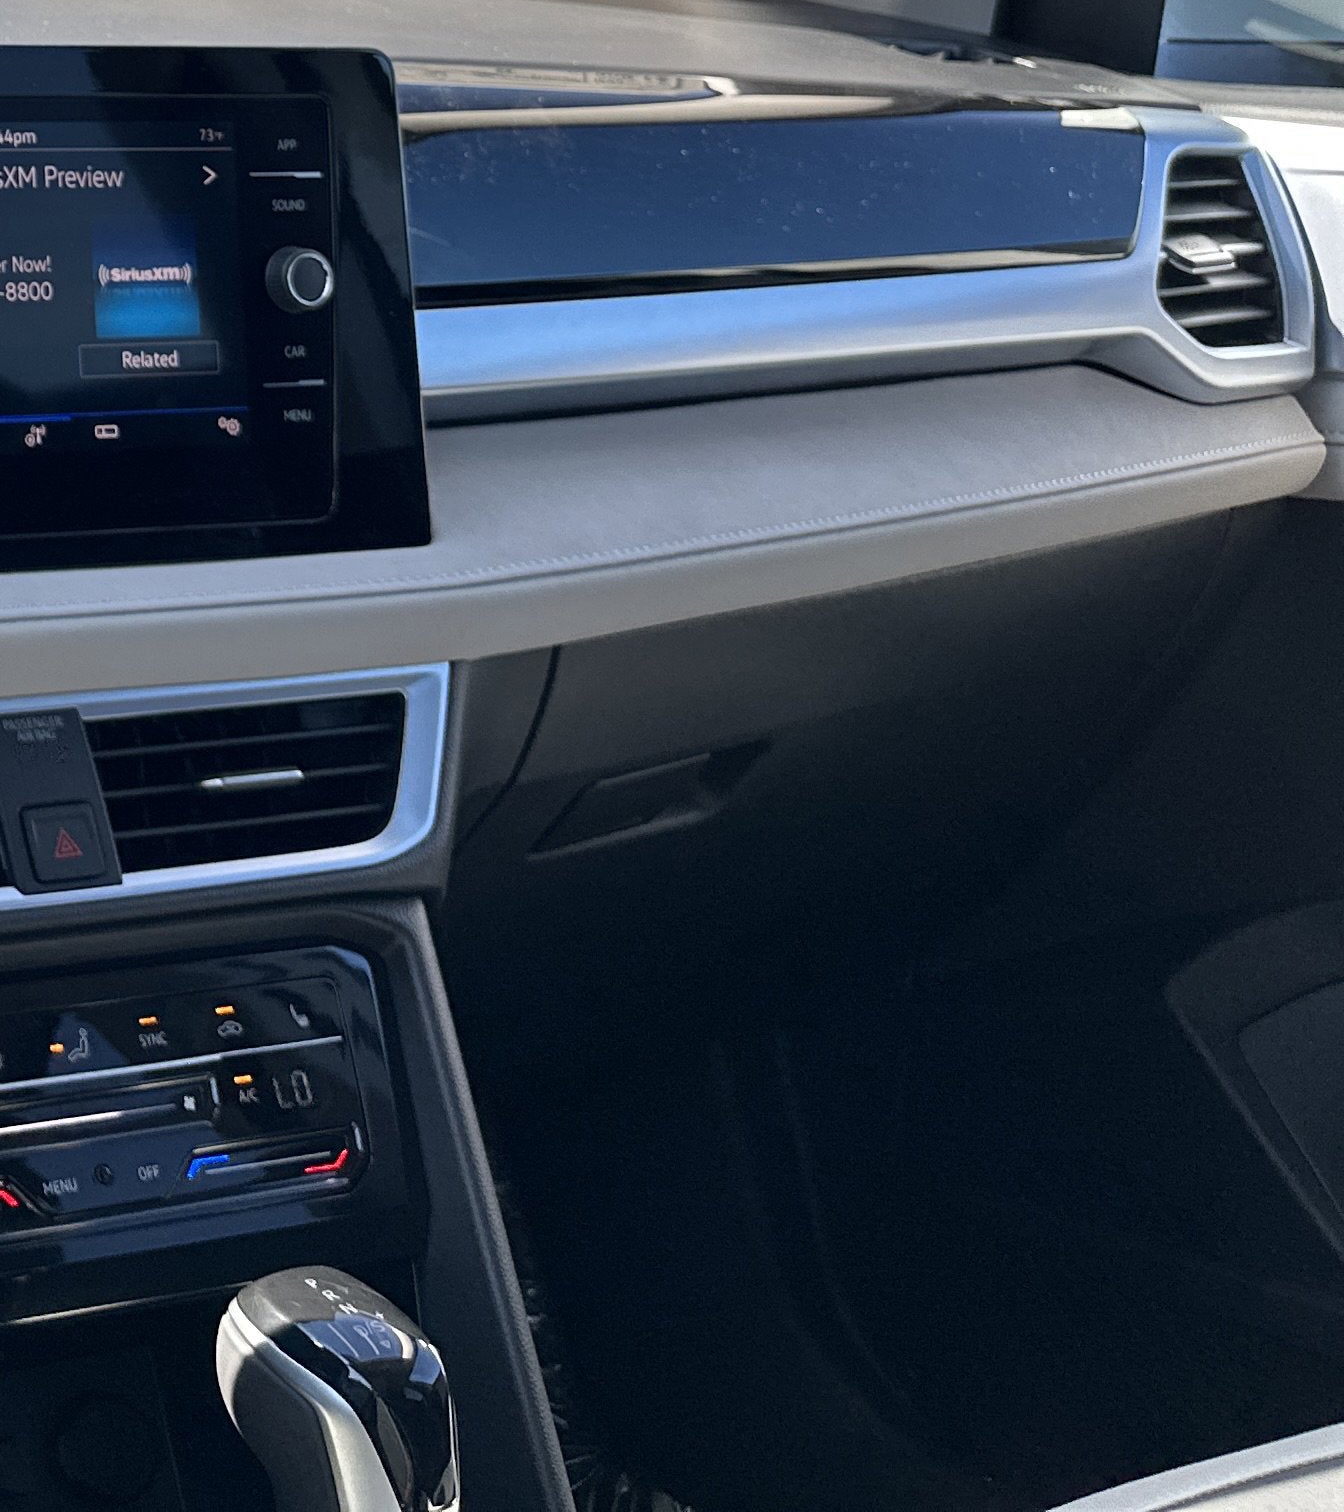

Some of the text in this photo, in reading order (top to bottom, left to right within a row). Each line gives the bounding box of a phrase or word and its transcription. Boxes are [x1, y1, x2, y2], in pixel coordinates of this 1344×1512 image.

[277, 139, 298, 151] APP
[44, 164, 124, 189] Preview
[271, 198, 306, 212] SOUND
[11, 254, 52, 273] Now!
[121, 349, 180, 369] Related
[283, 345, 307, 358] CAR
[283, 408, 313, 423] MENU
[138, 1031, 169, 1048] SYNC
[137, 1163, 160, 1181] OFF
[42, 1175, 81, 1196] MENU
[321, 1289, 341, 1301] R
[338, 1301, 359, 1315] N
